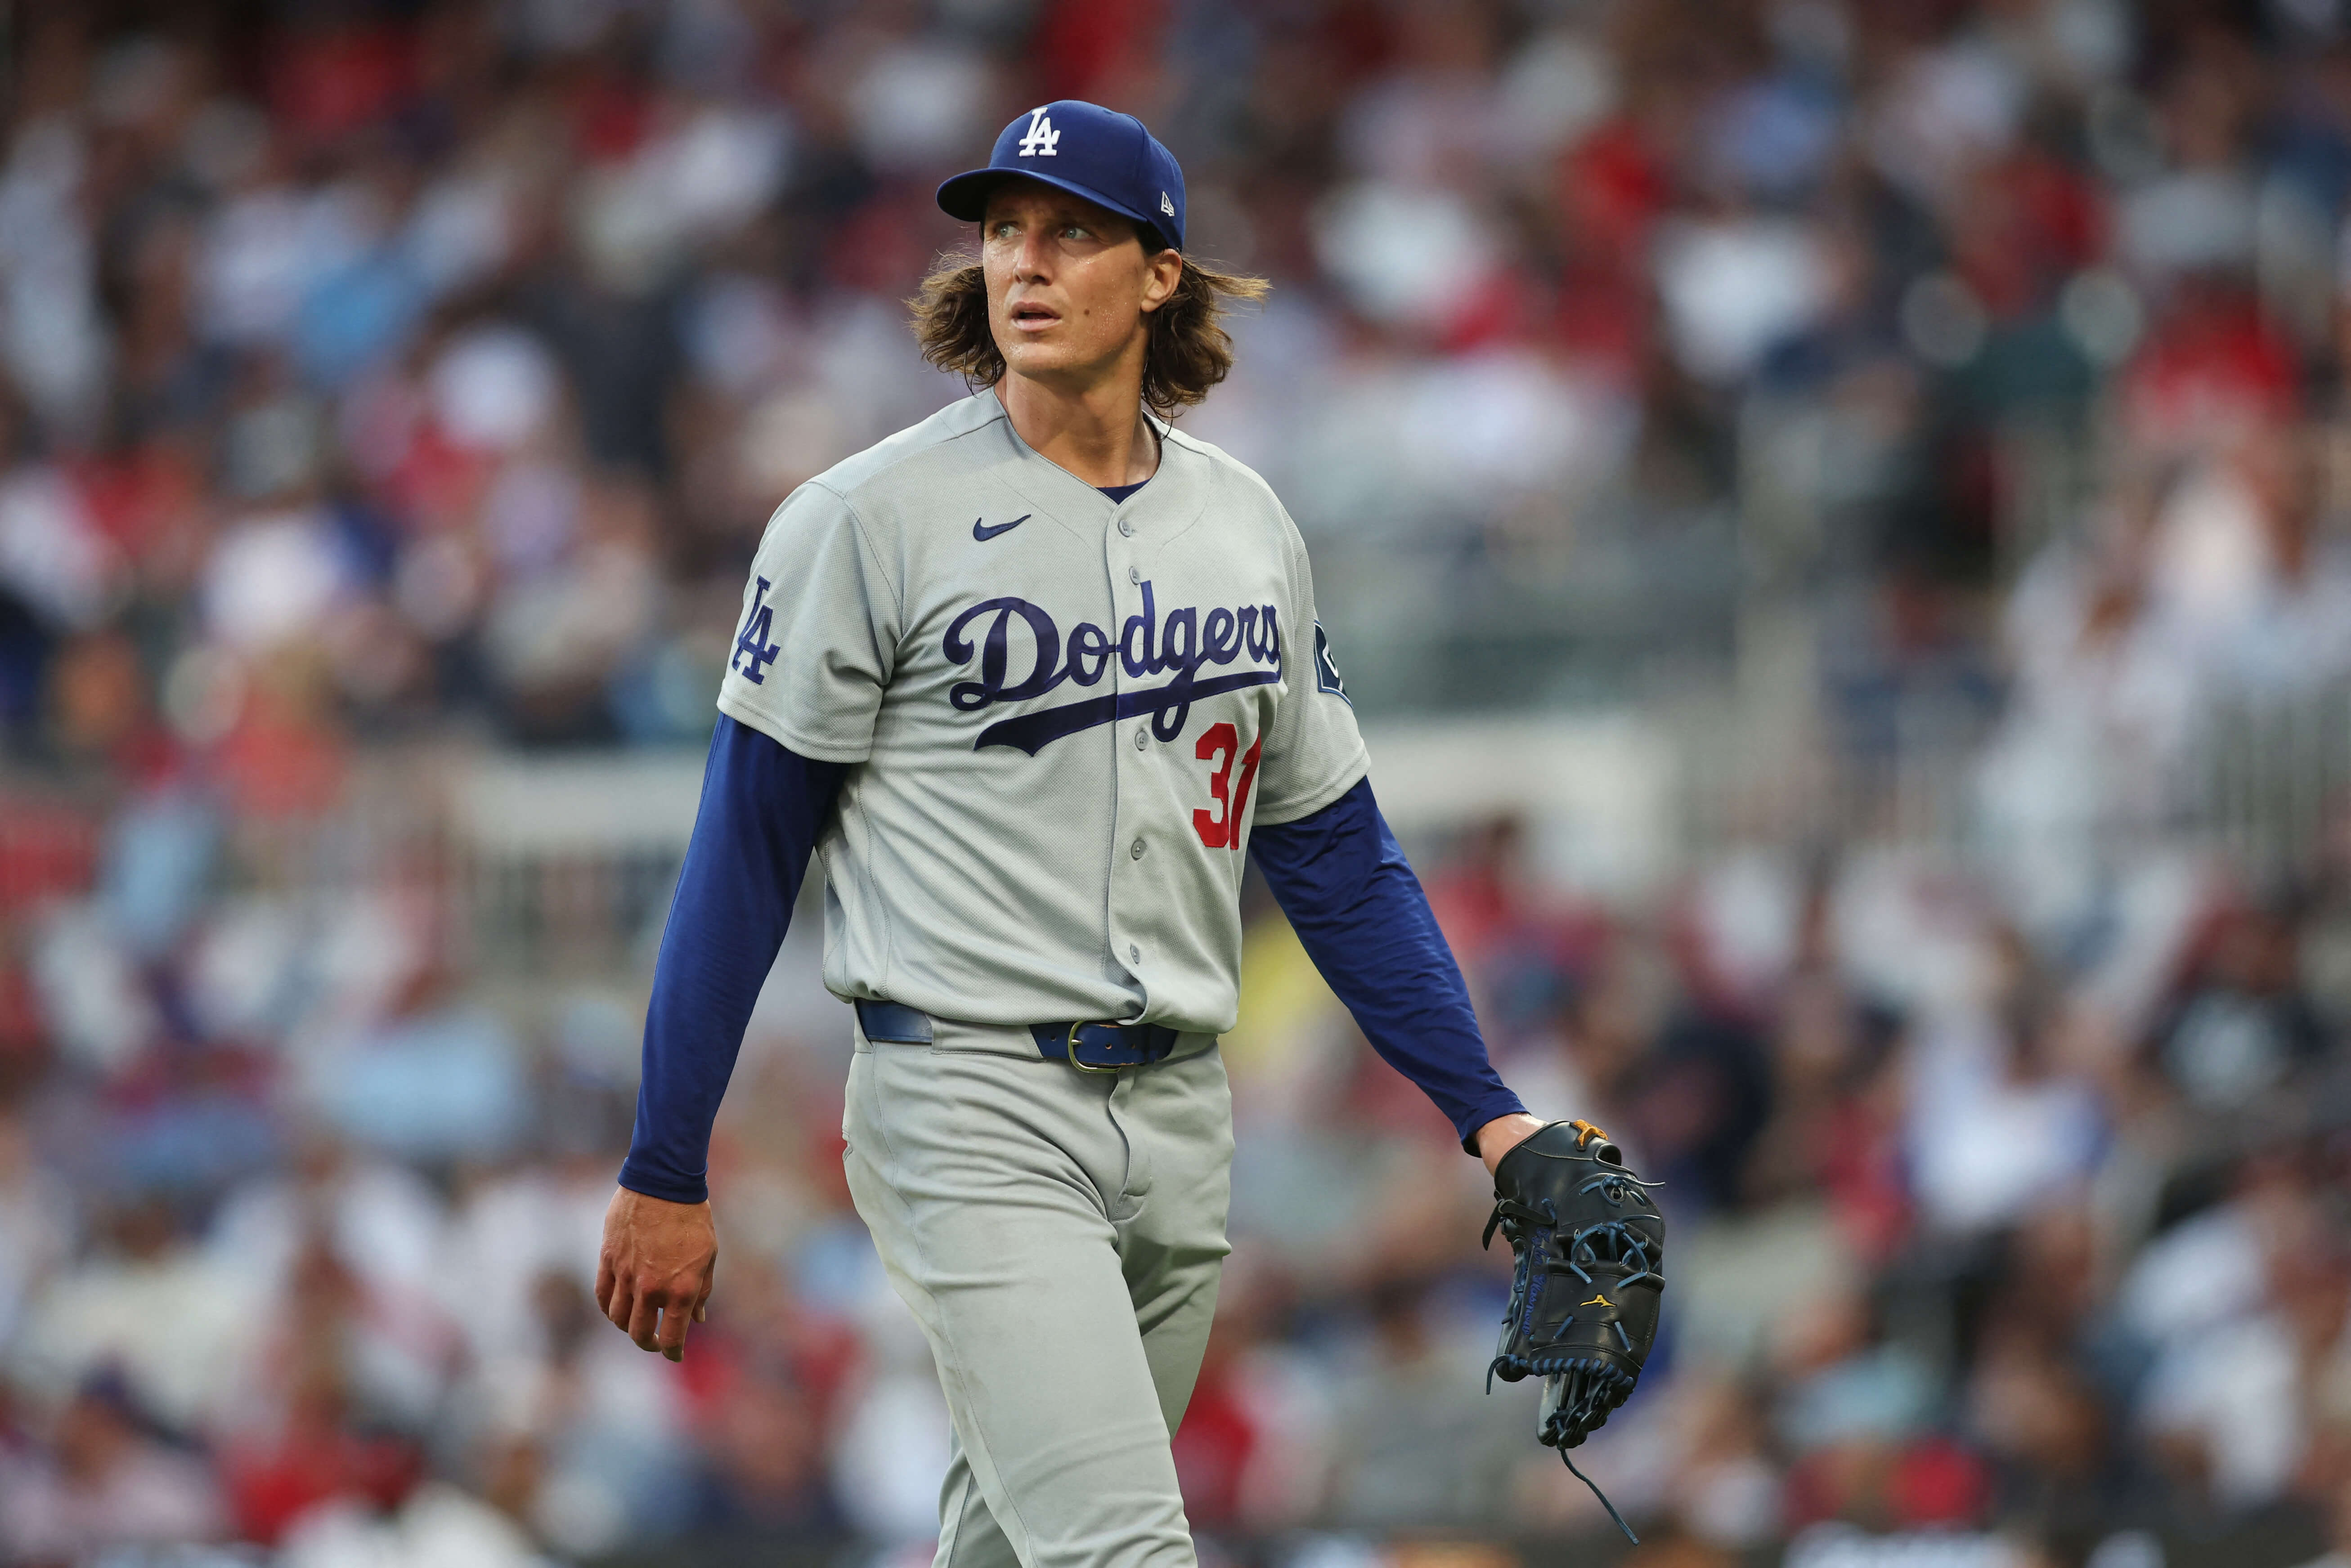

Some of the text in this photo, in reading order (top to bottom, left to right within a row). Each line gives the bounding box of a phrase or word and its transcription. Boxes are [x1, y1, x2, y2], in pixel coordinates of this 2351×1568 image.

[1019, 107, 1060, 157] LA
[732, 575, 781, 685] LA
[943, 579, 1282, 743] Dodgers
[1193, 722, 1260, 850] 31
